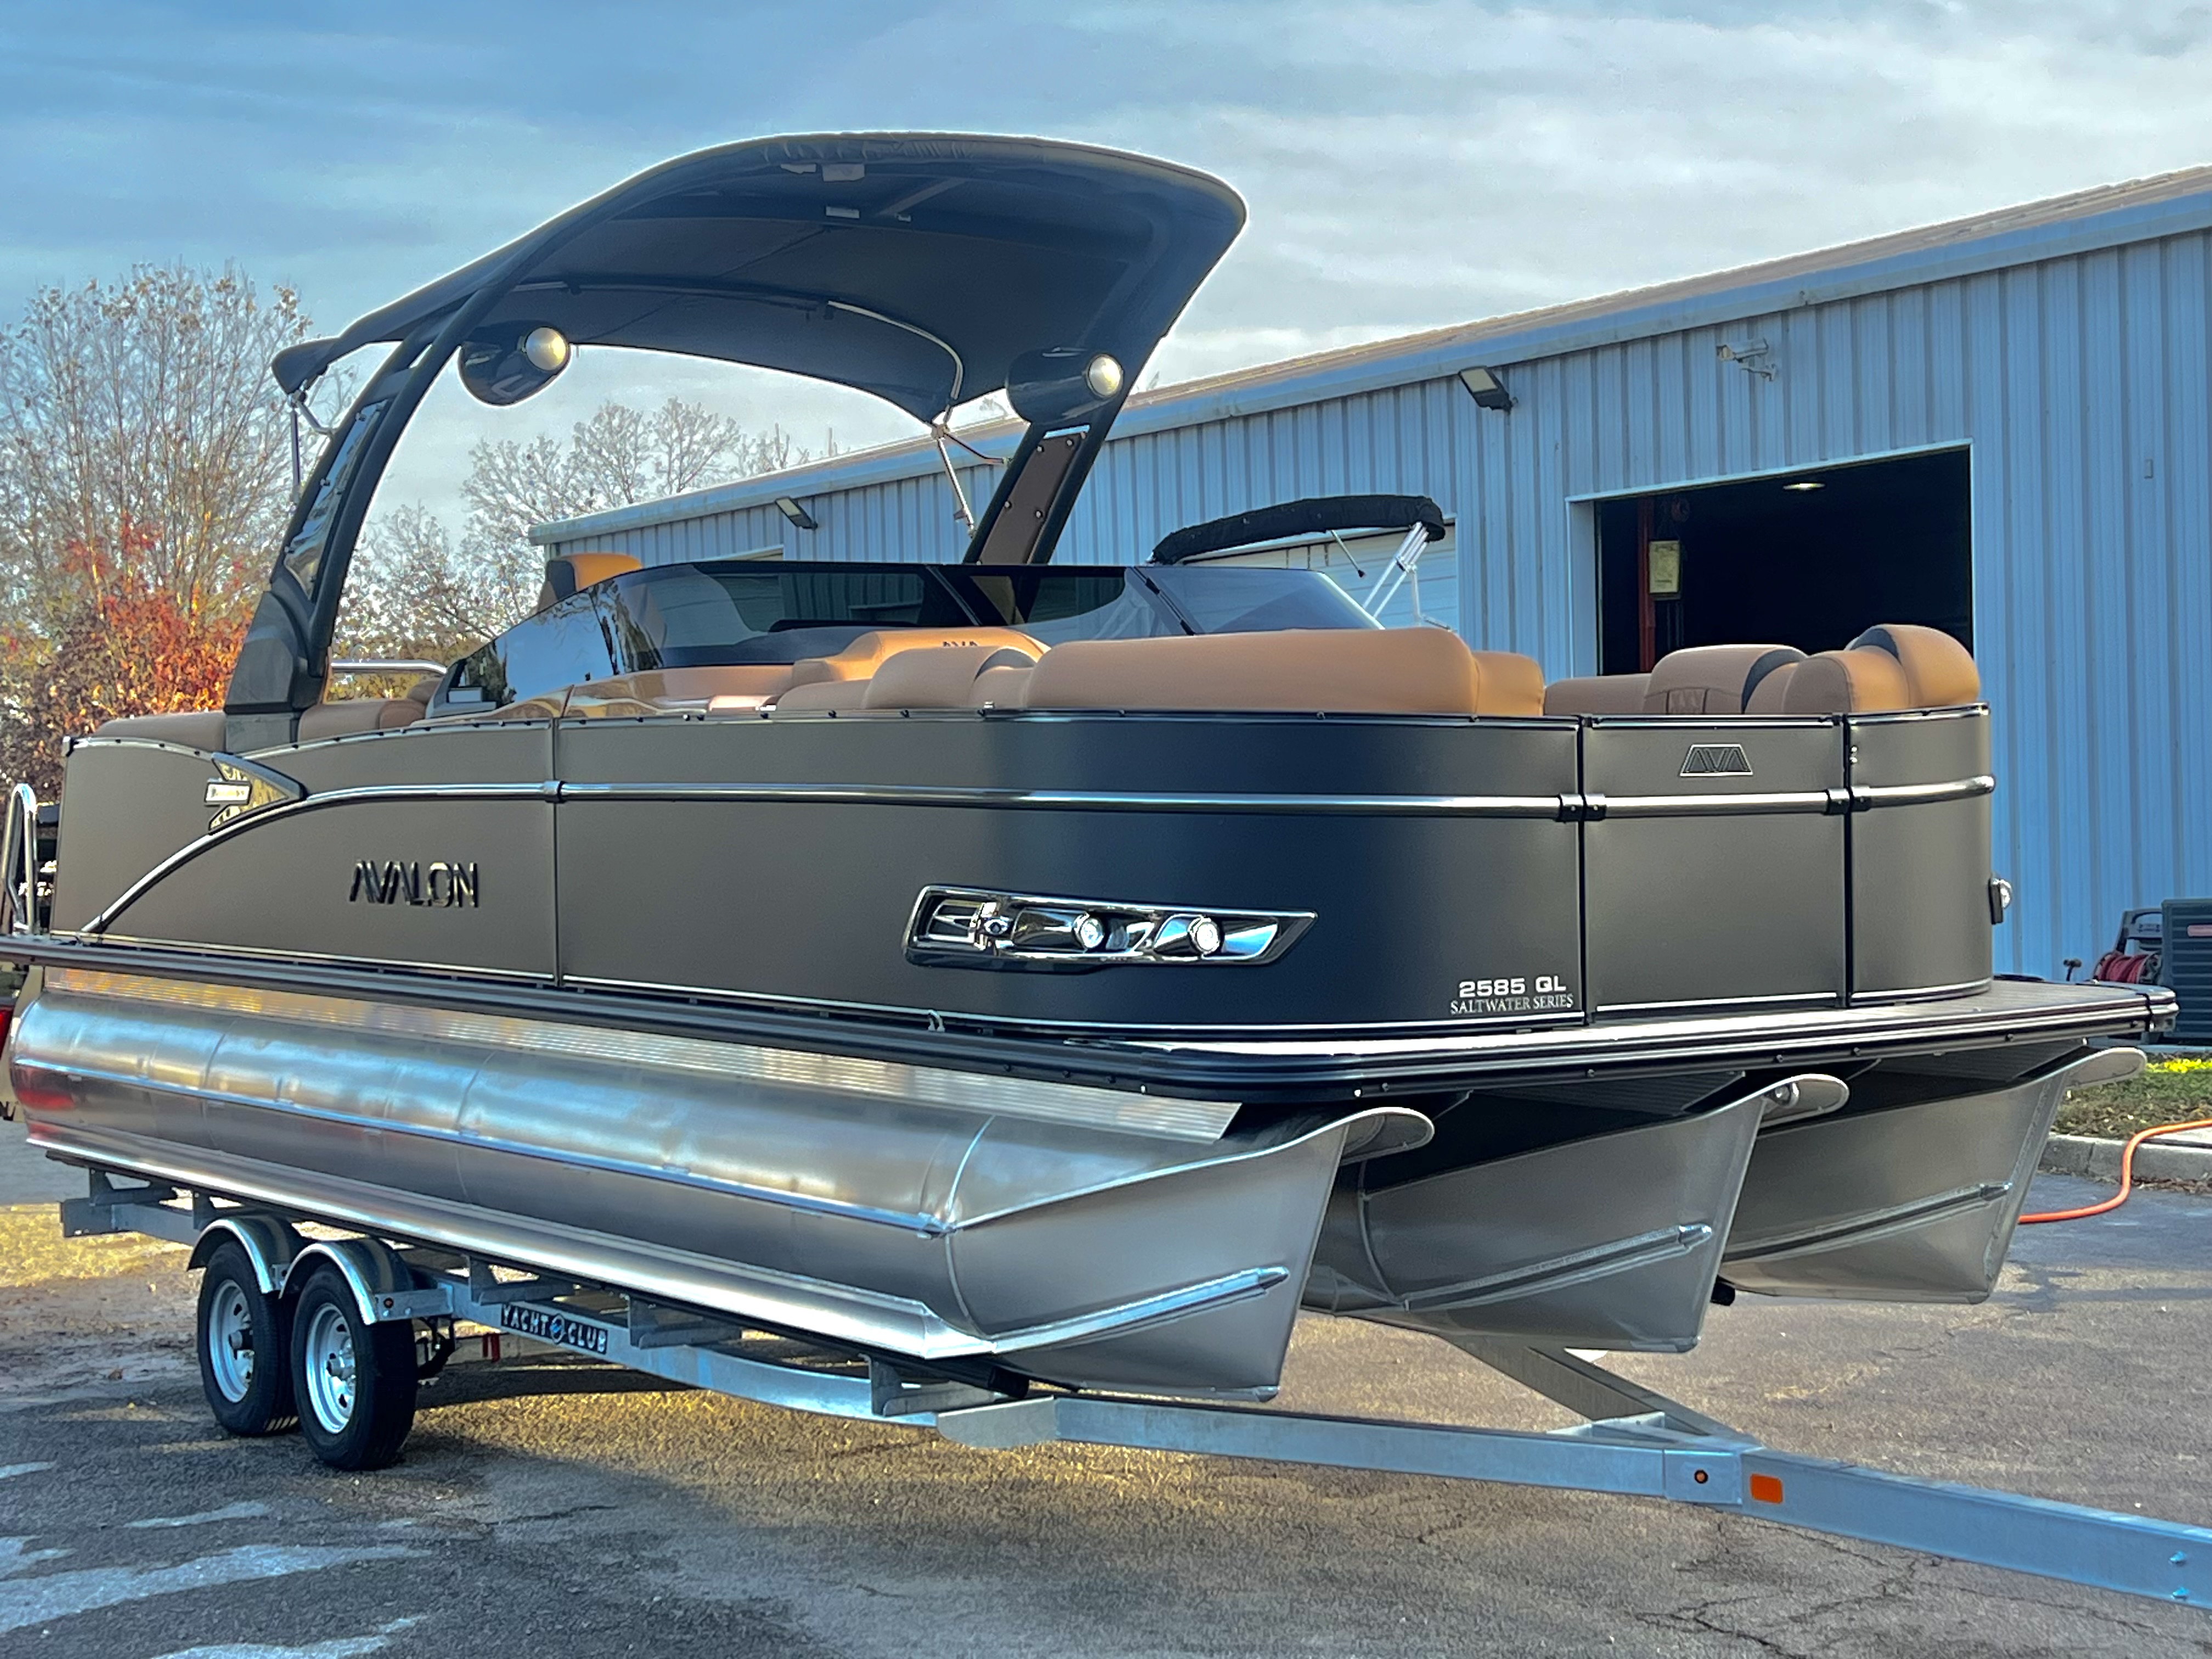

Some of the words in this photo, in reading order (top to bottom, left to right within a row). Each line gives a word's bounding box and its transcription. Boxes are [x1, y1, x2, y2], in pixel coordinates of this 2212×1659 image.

[349, 860, 479, 907] AVALON
[1451, 996, 1531, 1014] SALTWATER
[1533, 993, 1573, 1009] SERIES
[1459, 978, 1525, 998] 2585
[1536, 975, 1567, 992] QL
[502, 1304, 548, 1335] YACHT
[567, 1322, 606, 1352] CLUB
